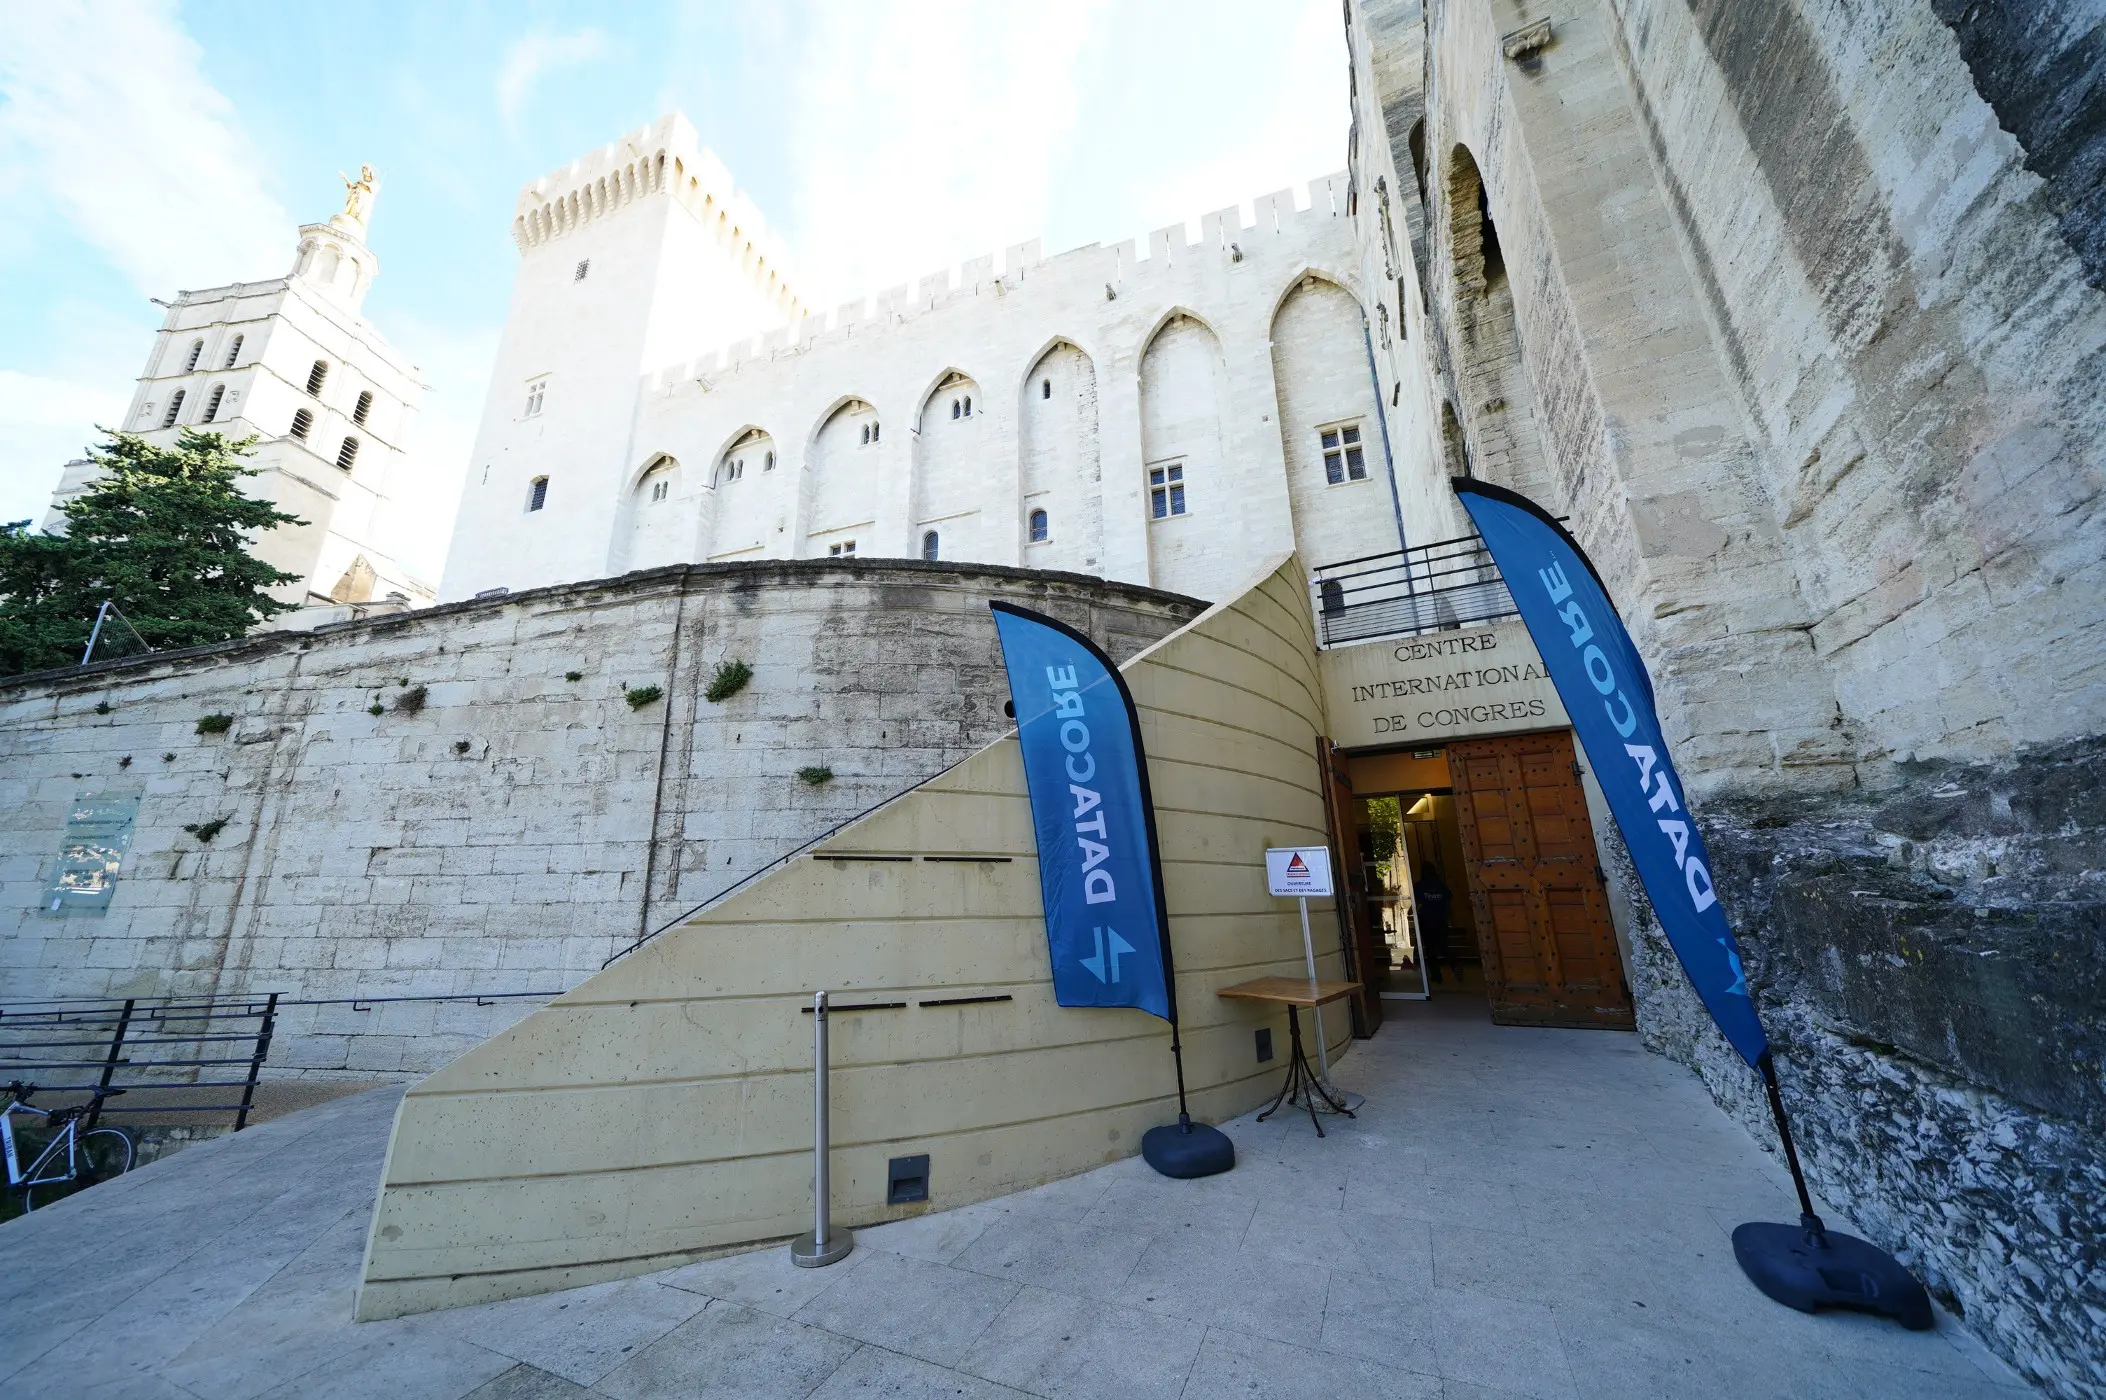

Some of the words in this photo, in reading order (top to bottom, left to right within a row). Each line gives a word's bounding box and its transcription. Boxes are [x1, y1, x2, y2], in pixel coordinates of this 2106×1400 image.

[1394, 634, 1497, 662] CENTRE
[1373, 715, 1407, 734] DE
[1417, 699, 1546, 728] CONGRES
